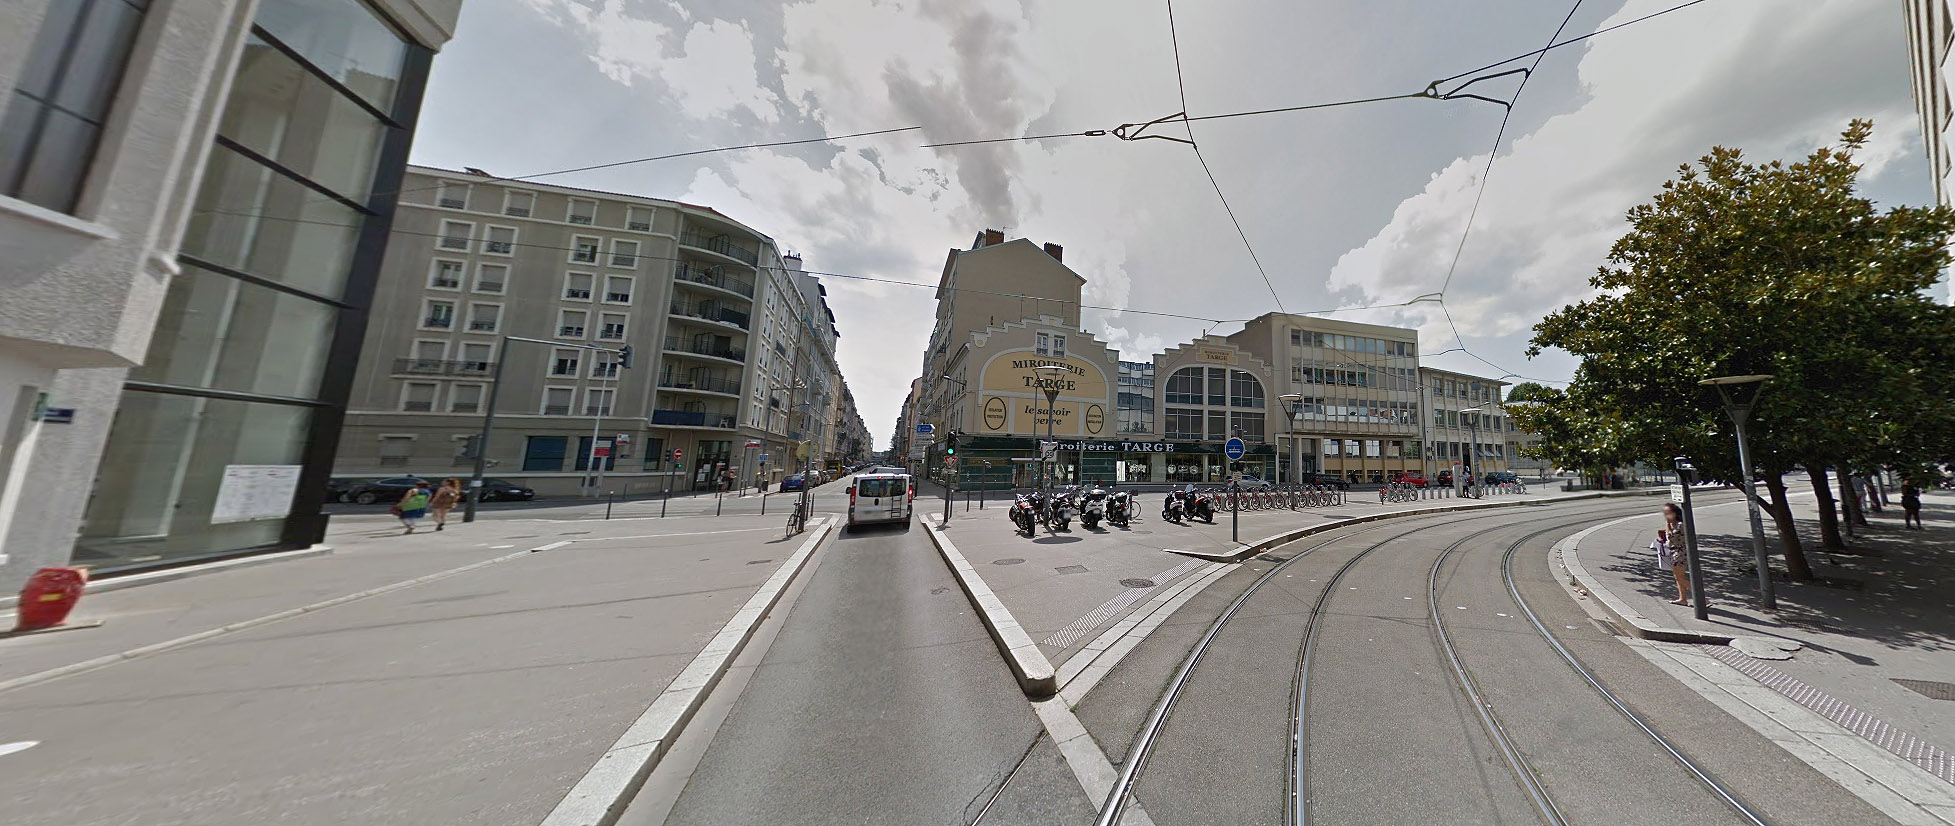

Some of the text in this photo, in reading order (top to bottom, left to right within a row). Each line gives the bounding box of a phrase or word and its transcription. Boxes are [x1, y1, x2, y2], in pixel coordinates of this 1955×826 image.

[1012, 359, 1086, 377] MIROITERIE
[1022, 376, 1076, 391] TARGE
[1024, 405, 1071, 416] le saoir
[1121, 442, 1174, 453] TARGE
